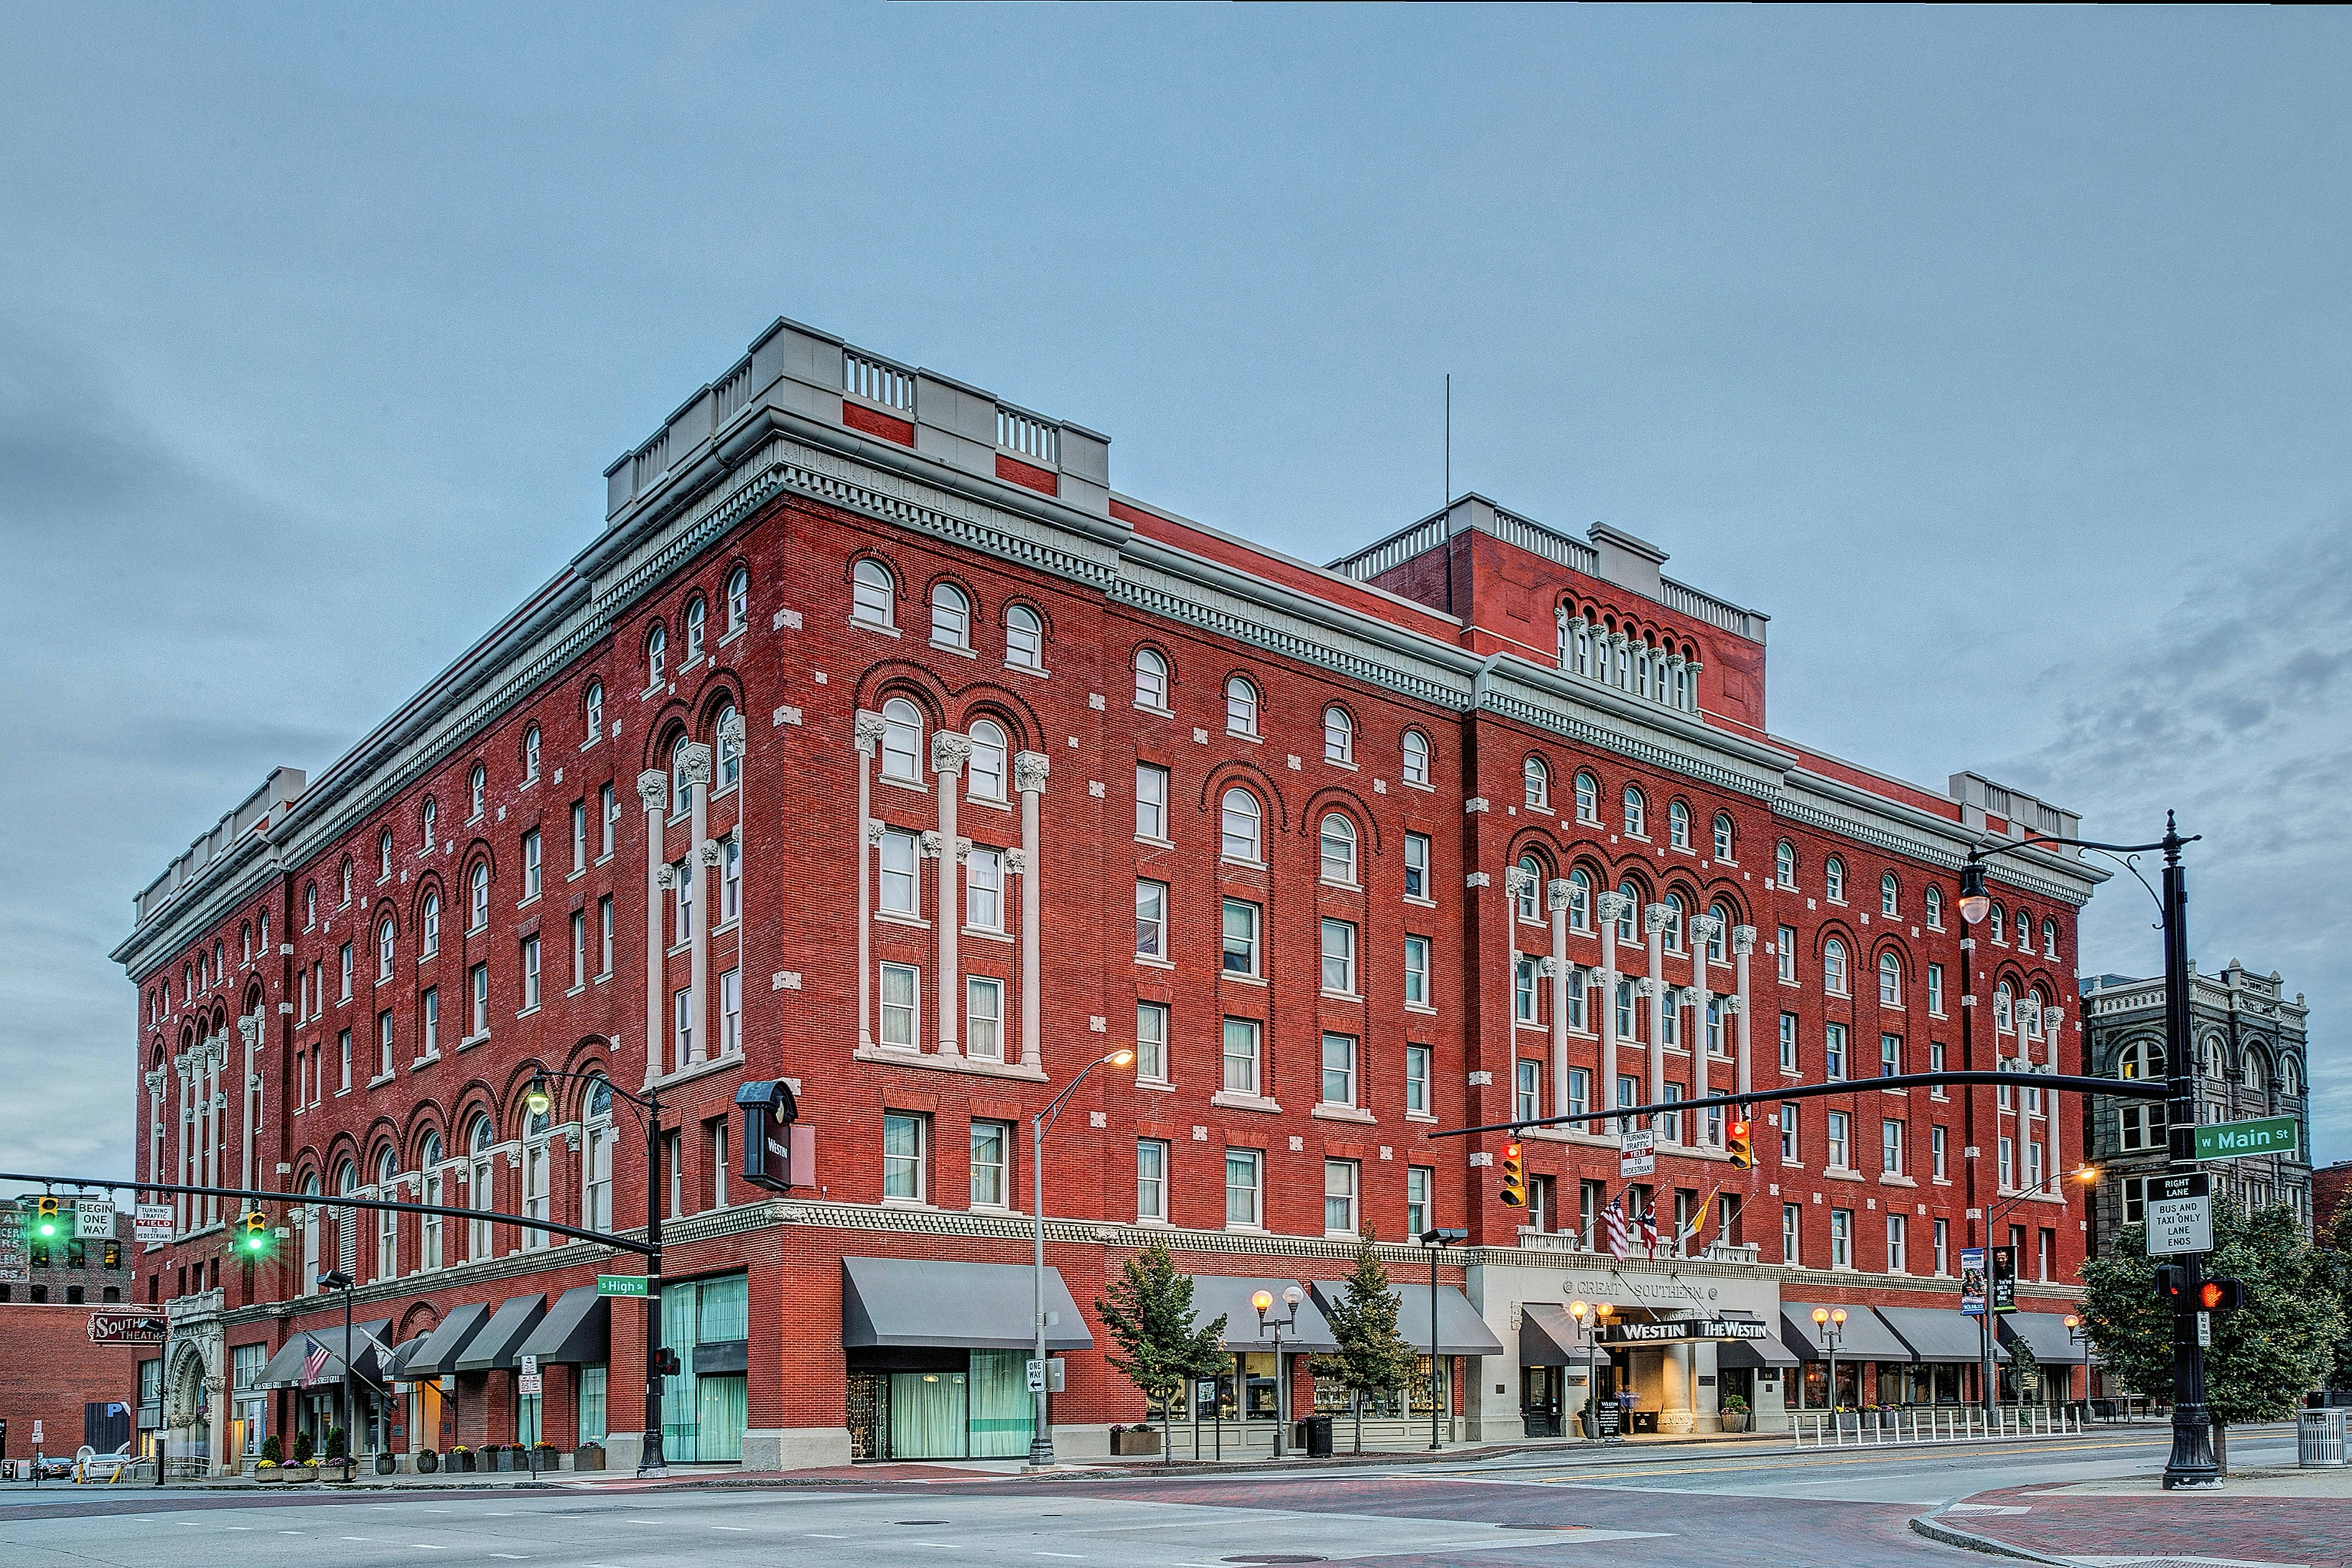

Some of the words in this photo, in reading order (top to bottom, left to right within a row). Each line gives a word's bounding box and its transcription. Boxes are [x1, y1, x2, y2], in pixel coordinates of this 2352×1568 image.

[1626, 1132, 1649, 1142] TURNING
[2201, 1138, 2211, 1147] W
[2218, 1129, 2270, 1149] Main
[2276, 1129, 2288, 1139] St
[767, 1137, 787, 1159] WESTIN
[1626, 1141, 1649, 1150] TRAFFIC
[1630, 1149, 1646, 1158] YIELD
[1623, 1164, 1652, 1175] PEDESTRIANS
[2165, 1179, 2190, 1188] RIGHT
[2166, 1188, 2189, 1197] LANE
[79, 1204, 112, 1213] BEGIN
[2160, 1205, 2177, 1213] BUS
[2180, 1203, 2197, 1212] AND
[83, 1215, 107, 1224] ONE
[2157, 1216, 2174, 1225] TAXI
[2178, 1213, 2200, 1223] ONLY
[83, 1225, 108, 1234] WAY
[2168, 1226, 2190, 1235] LANE
[2168, 1238, 2191, 1246] ENDS
[608, 1281, 634, 1294] High
[1578, 1281, 1622, 1296] GREAT
[96, 1317, 163, 1338] SOUTH
[1622, 1323, 1686, 1340] WESTIN
[1029, 1362, 1041, 1370] ONE
[107, 1403, 122, 1417] P
